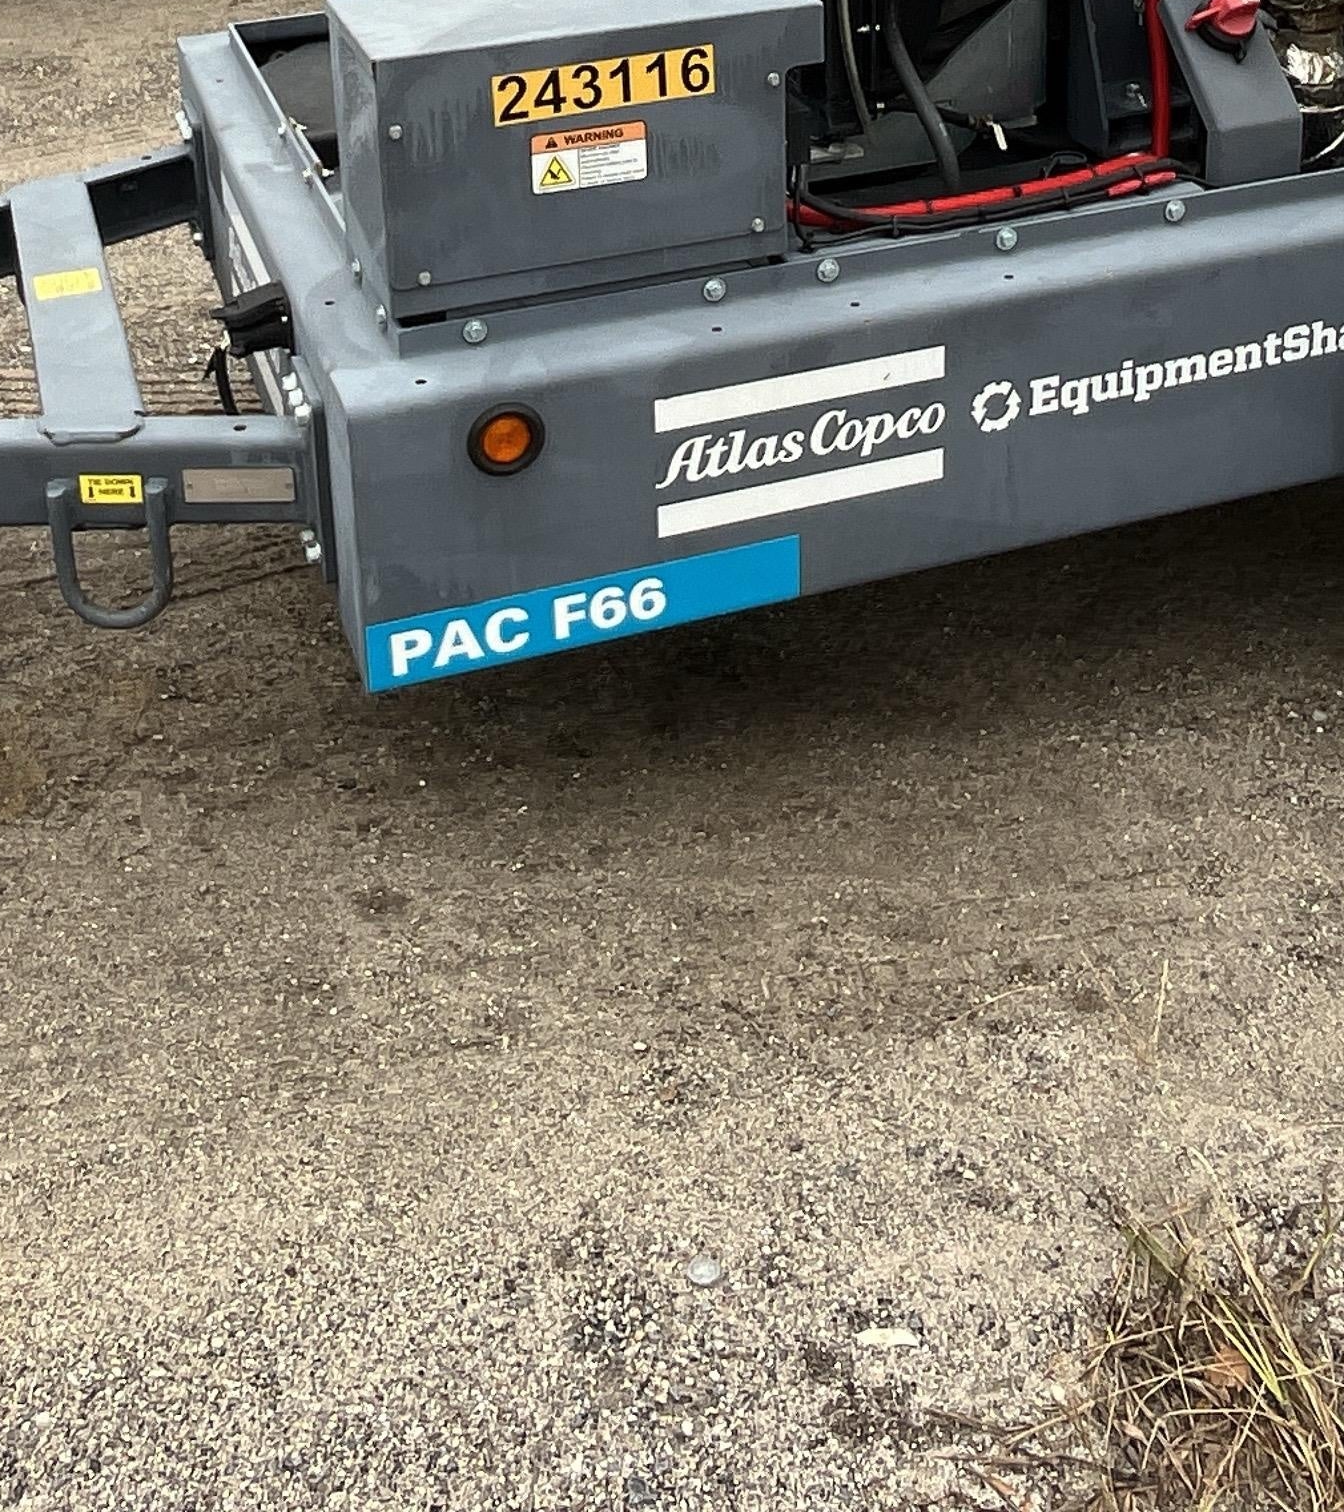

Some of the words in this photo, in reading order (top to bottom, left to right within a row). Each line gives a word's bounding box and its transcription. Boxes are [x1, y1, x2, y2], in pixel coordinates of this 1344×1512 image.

[497, 48, 711, 122] 243116
[564, 128, 624, 145] WARNING
[656, 429, 805, 489] Atlas
[810, 402, 946, 457] Copco
[391, 607, 530, 676] PAC
[553, 578, 667, 640] F66
